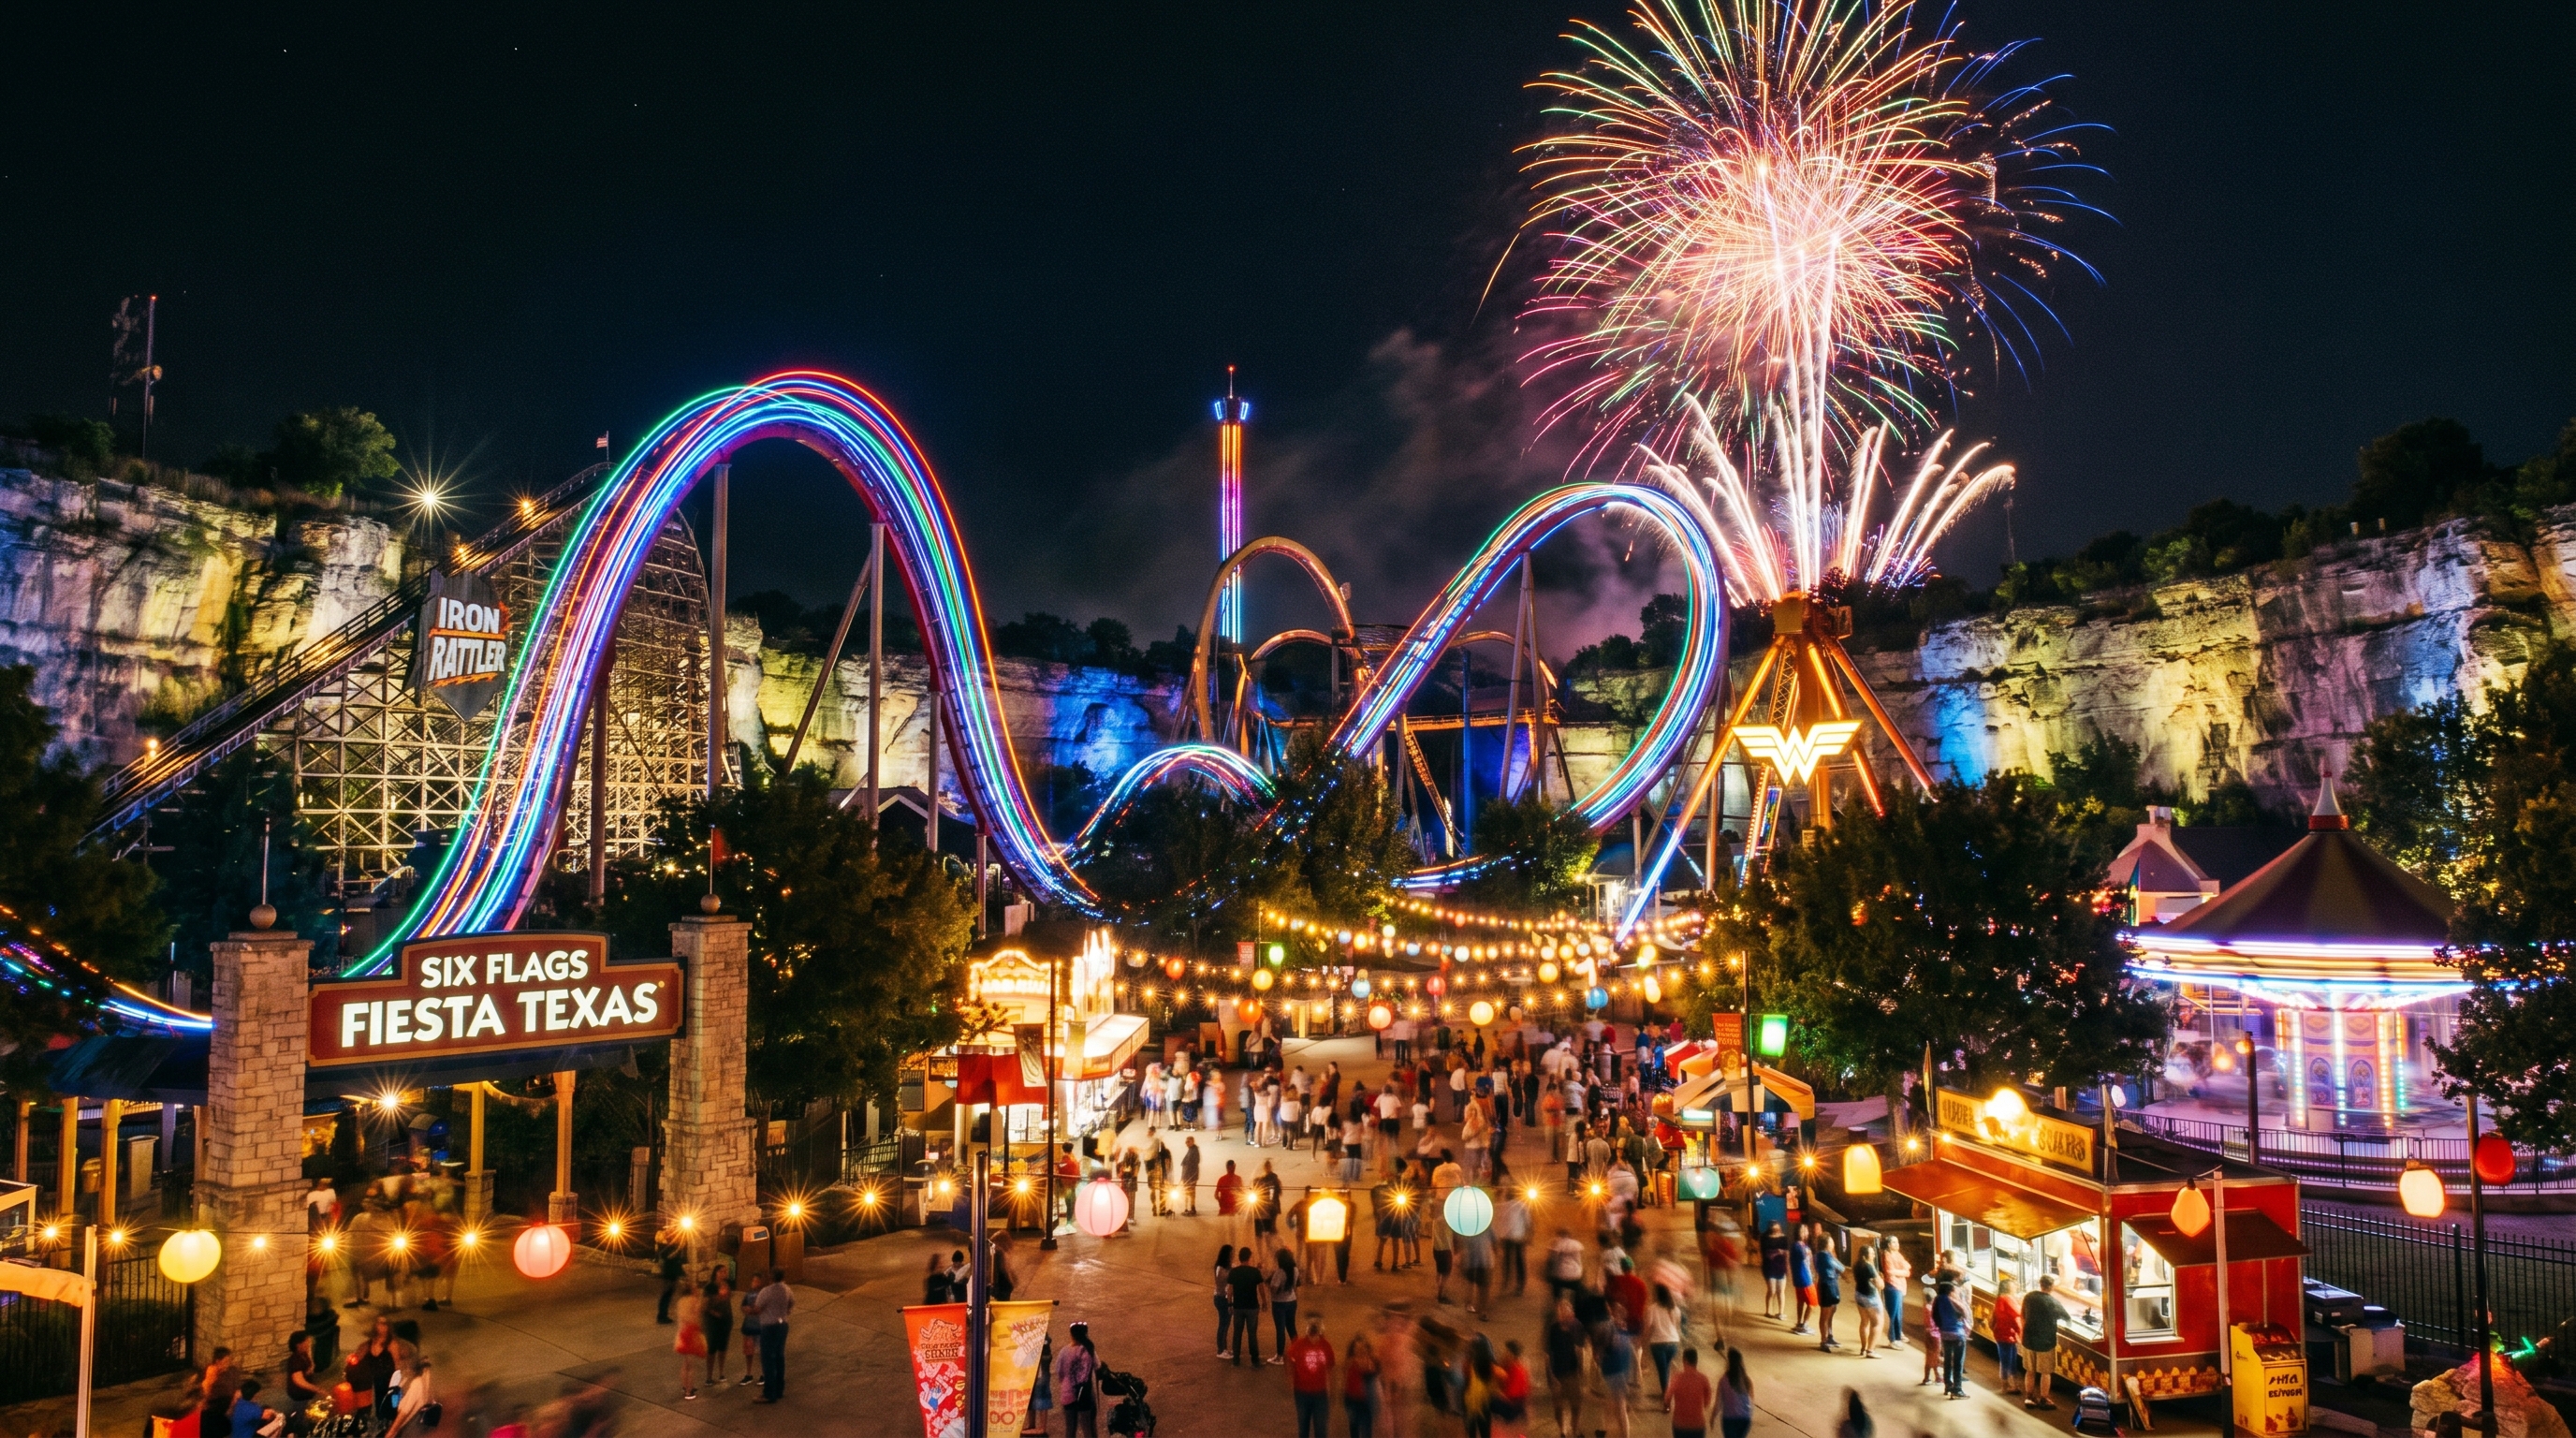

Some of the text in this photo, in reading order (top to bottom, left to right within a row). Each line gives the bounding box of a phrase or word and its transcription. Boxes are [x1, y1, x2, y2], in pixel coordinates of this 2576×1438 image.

[438, 596, 500, 635] IRON
[428, 636, 507, 682] RATTLER
[420, 956, 477, 989] SIX
[486, 949, 589, 985] FLAGS
[341, 993, 506, 1048] FIESTA
[517, 982, 658, 1033] TEXAS
